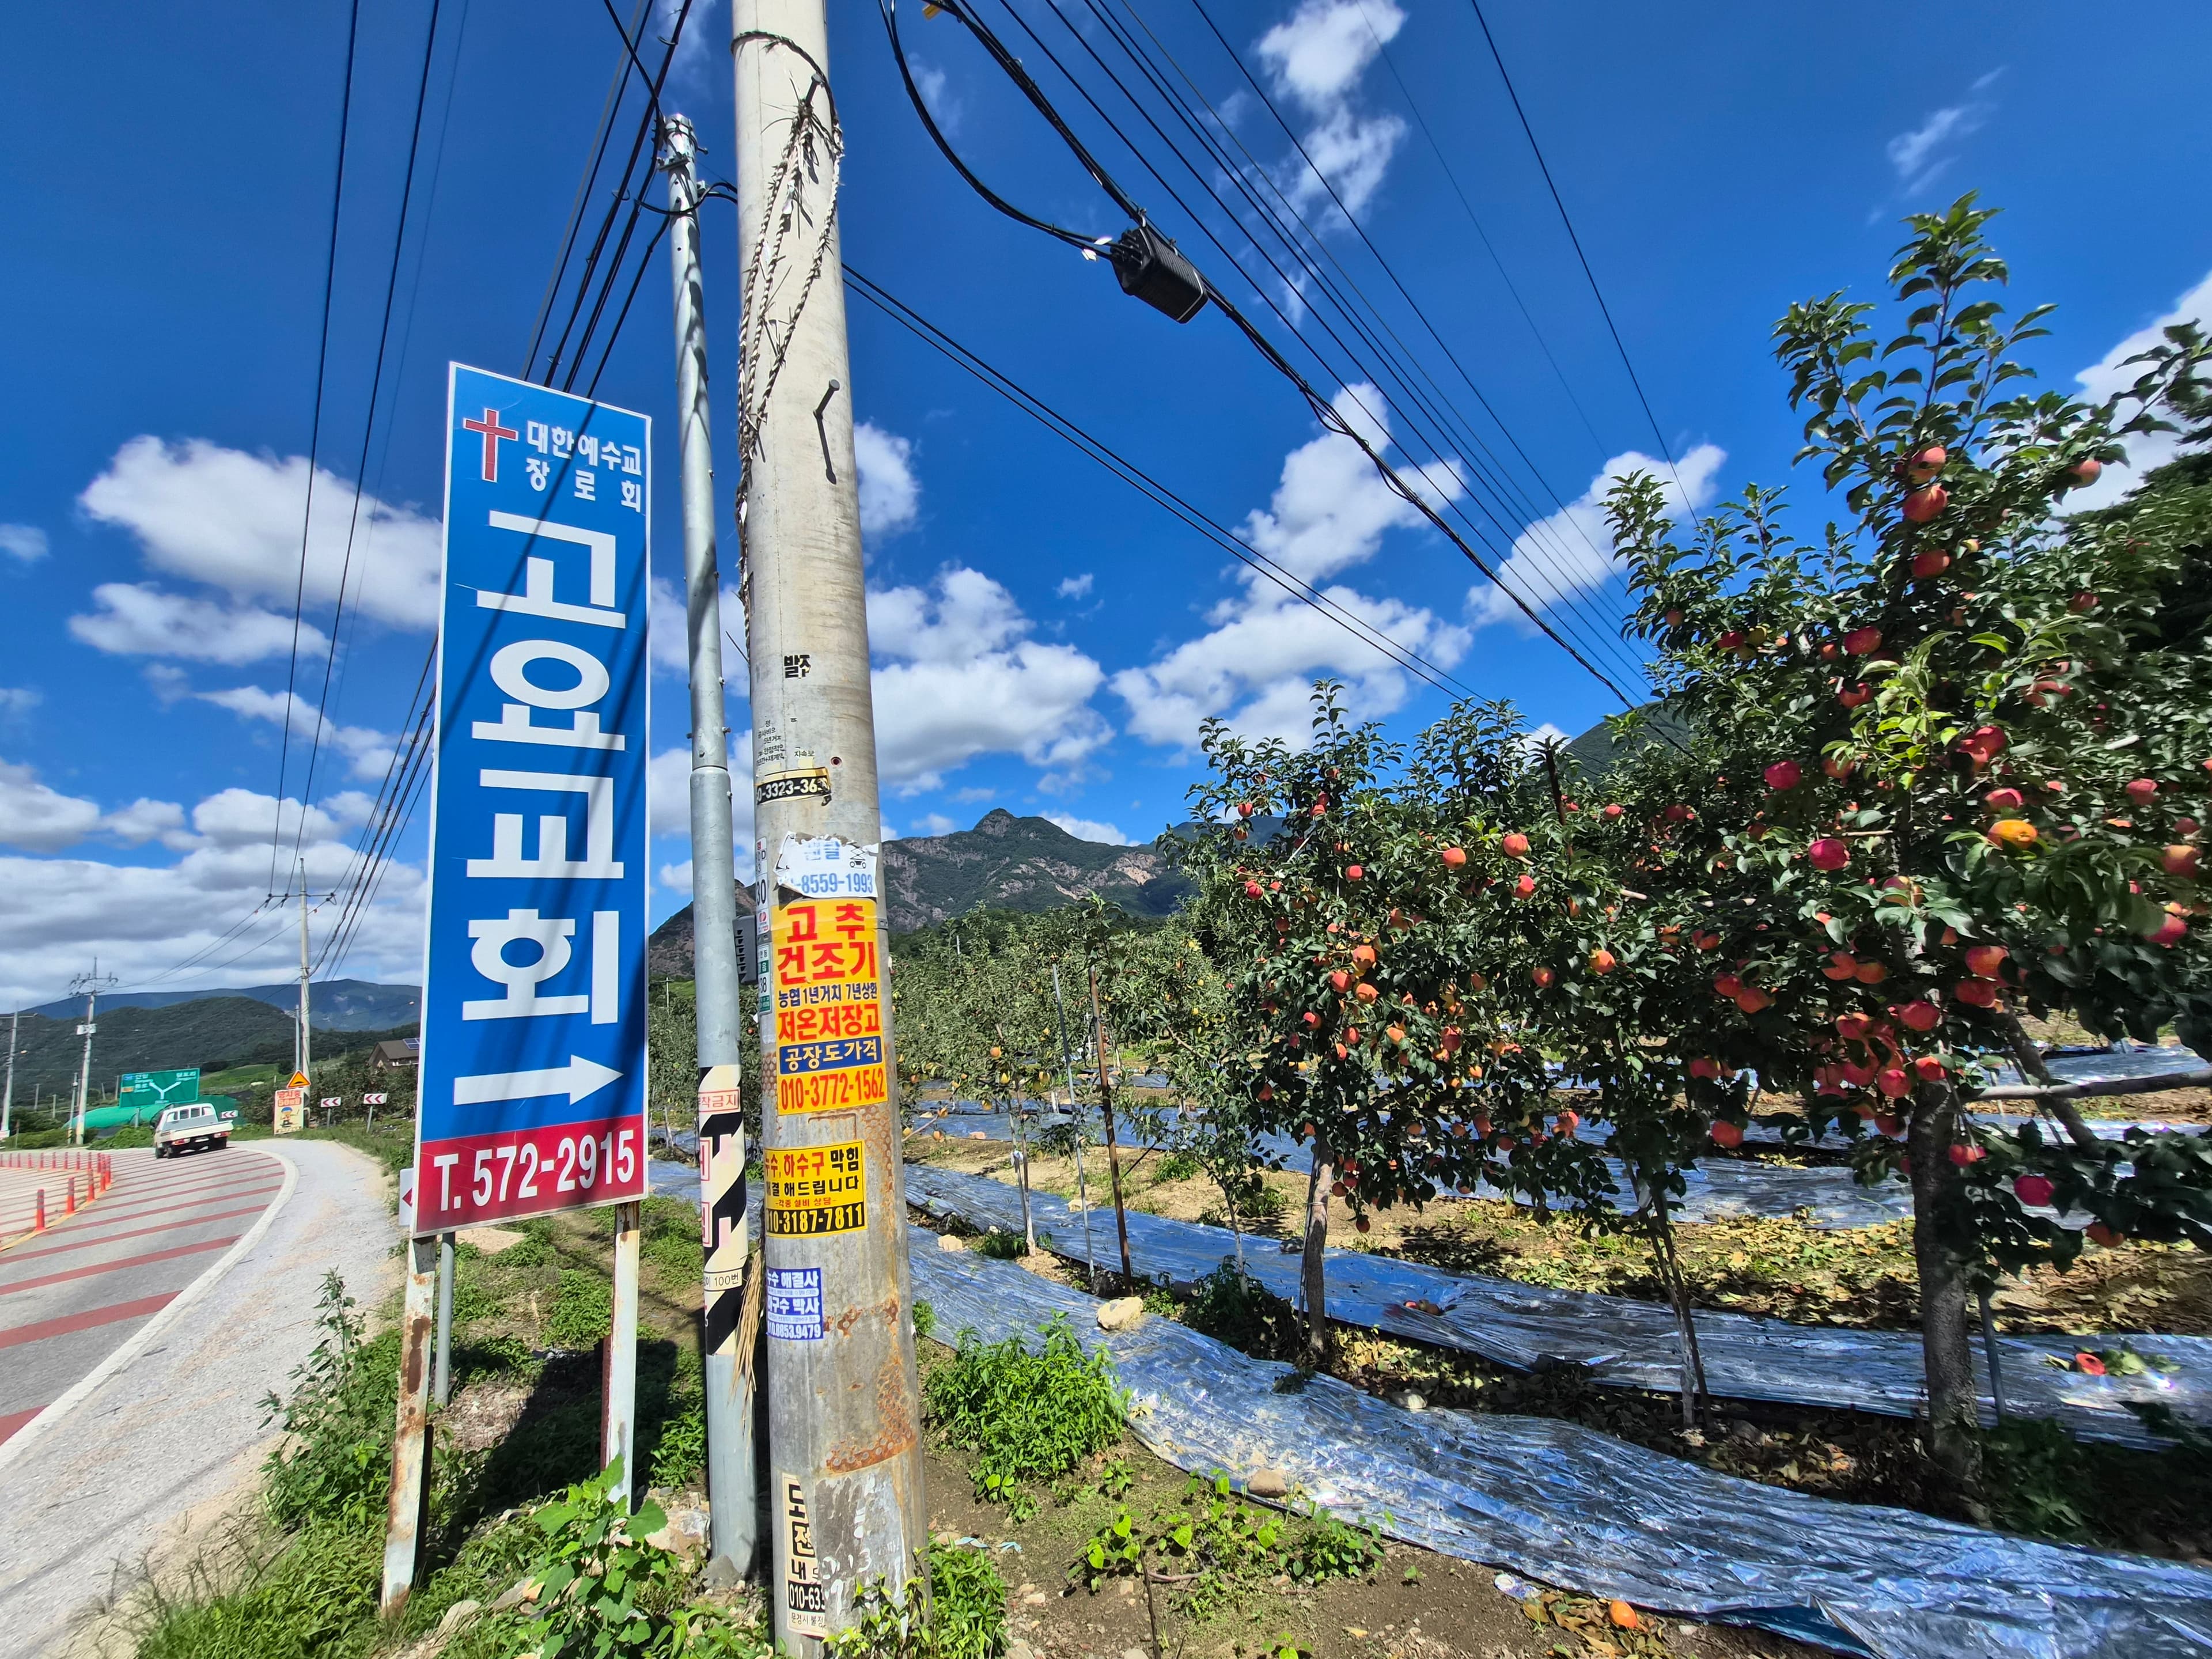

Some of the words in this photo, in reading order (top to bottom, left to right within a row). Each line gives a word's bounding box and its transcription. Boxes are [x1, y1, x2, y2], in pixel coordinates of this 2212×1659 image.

[527, 420, 642, 476] 대한예수교
[462, 510, 626, 1025] 고요교회
[789, 873, 874, 893] -8559-1993
[787, 903, 865, 943] 고추
[778, 942, 877, 986] 건조기
[778, 988, 801, 1009] 농협
[802, 983, 842, 1004] 1년거치
[845, 982, 877, 1001] 7년상환
[778, 1003, 880, 1042] 저온저장고
[785, 1039, 878, 1071] 공장도가격
[781, 1067, 885, 1111] 010-3772-1562
[783, 1152, 824, 1178] 하수구
[830, 1146, 859, 1173] 막힘
[784, 1175, 859, 1196] 해드립니다
[794, 1199, 809, 1207] 설비
[714, 1272, 738, 1287] 100번
[793, 1297, 820, 1316] 박사
